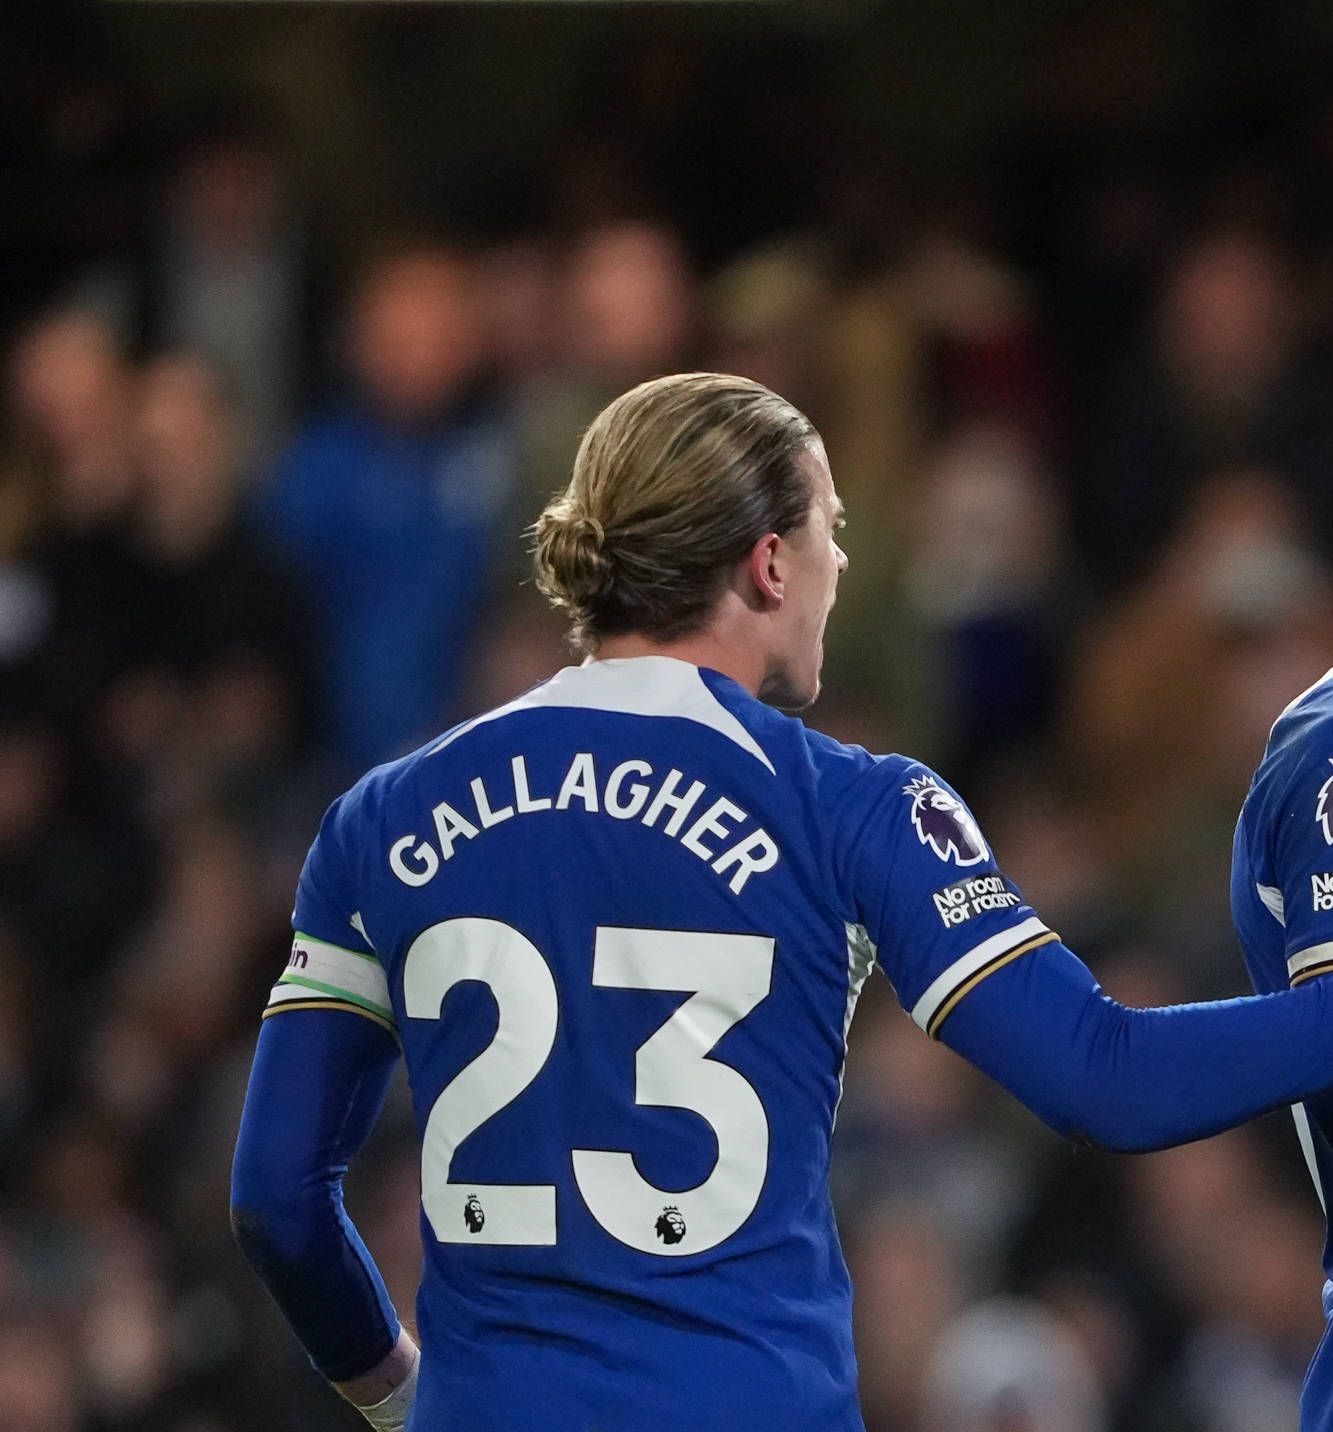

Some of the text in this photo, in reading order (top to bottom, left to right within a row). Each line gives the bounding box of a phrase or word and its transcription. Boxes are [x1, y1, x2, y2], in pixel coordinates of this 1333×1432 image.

[388, 752, 780, 896] GALLAGHER
[932, 877, 1005, 912] No room
[940, 902, 971, 928] for
[402, 915, 777, 1257] 23
